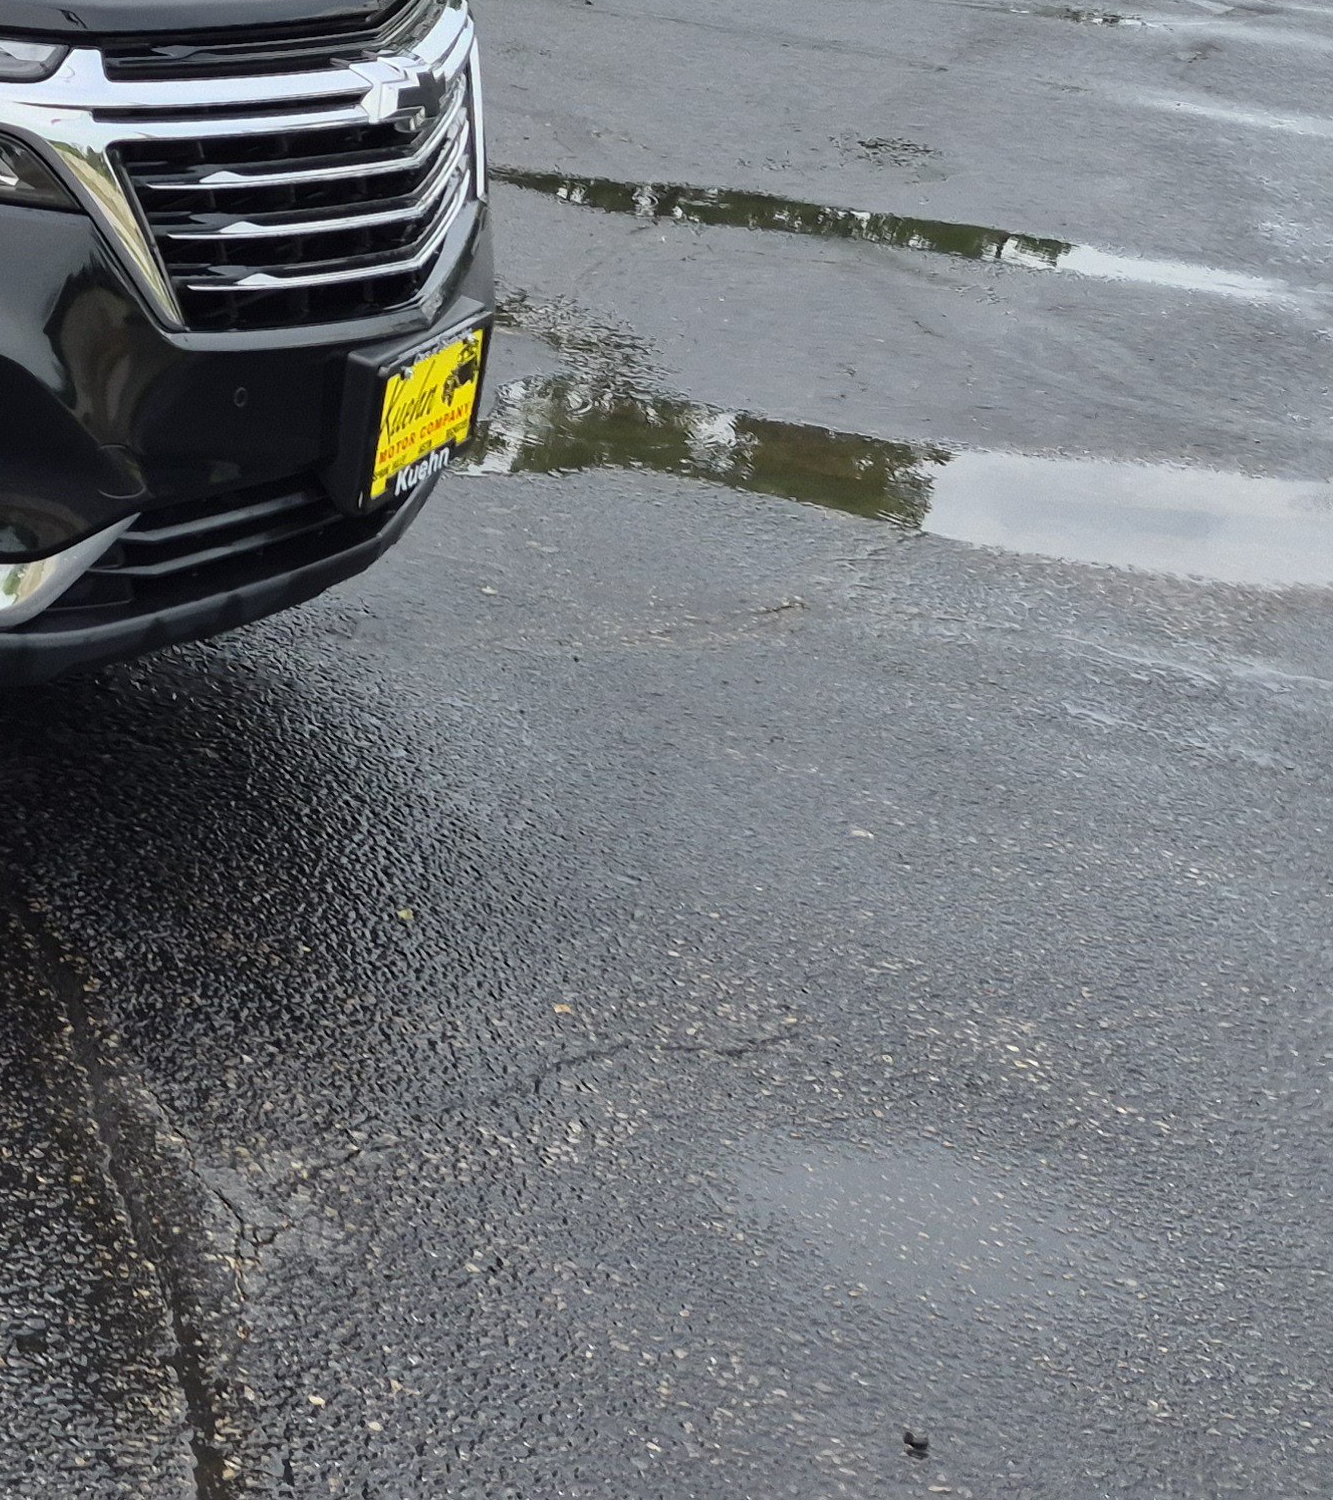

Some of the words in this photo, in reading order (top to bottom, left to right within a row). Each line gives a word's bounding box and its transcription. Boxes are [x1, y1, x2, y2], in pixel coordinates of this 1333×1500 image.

[379, 432, 416, 464] MOTOR
[420, 402, 469, 439] COMPANY
[380, 360, 438, 445] Kuehn
[394, 446, 450, 497] Kuehn
